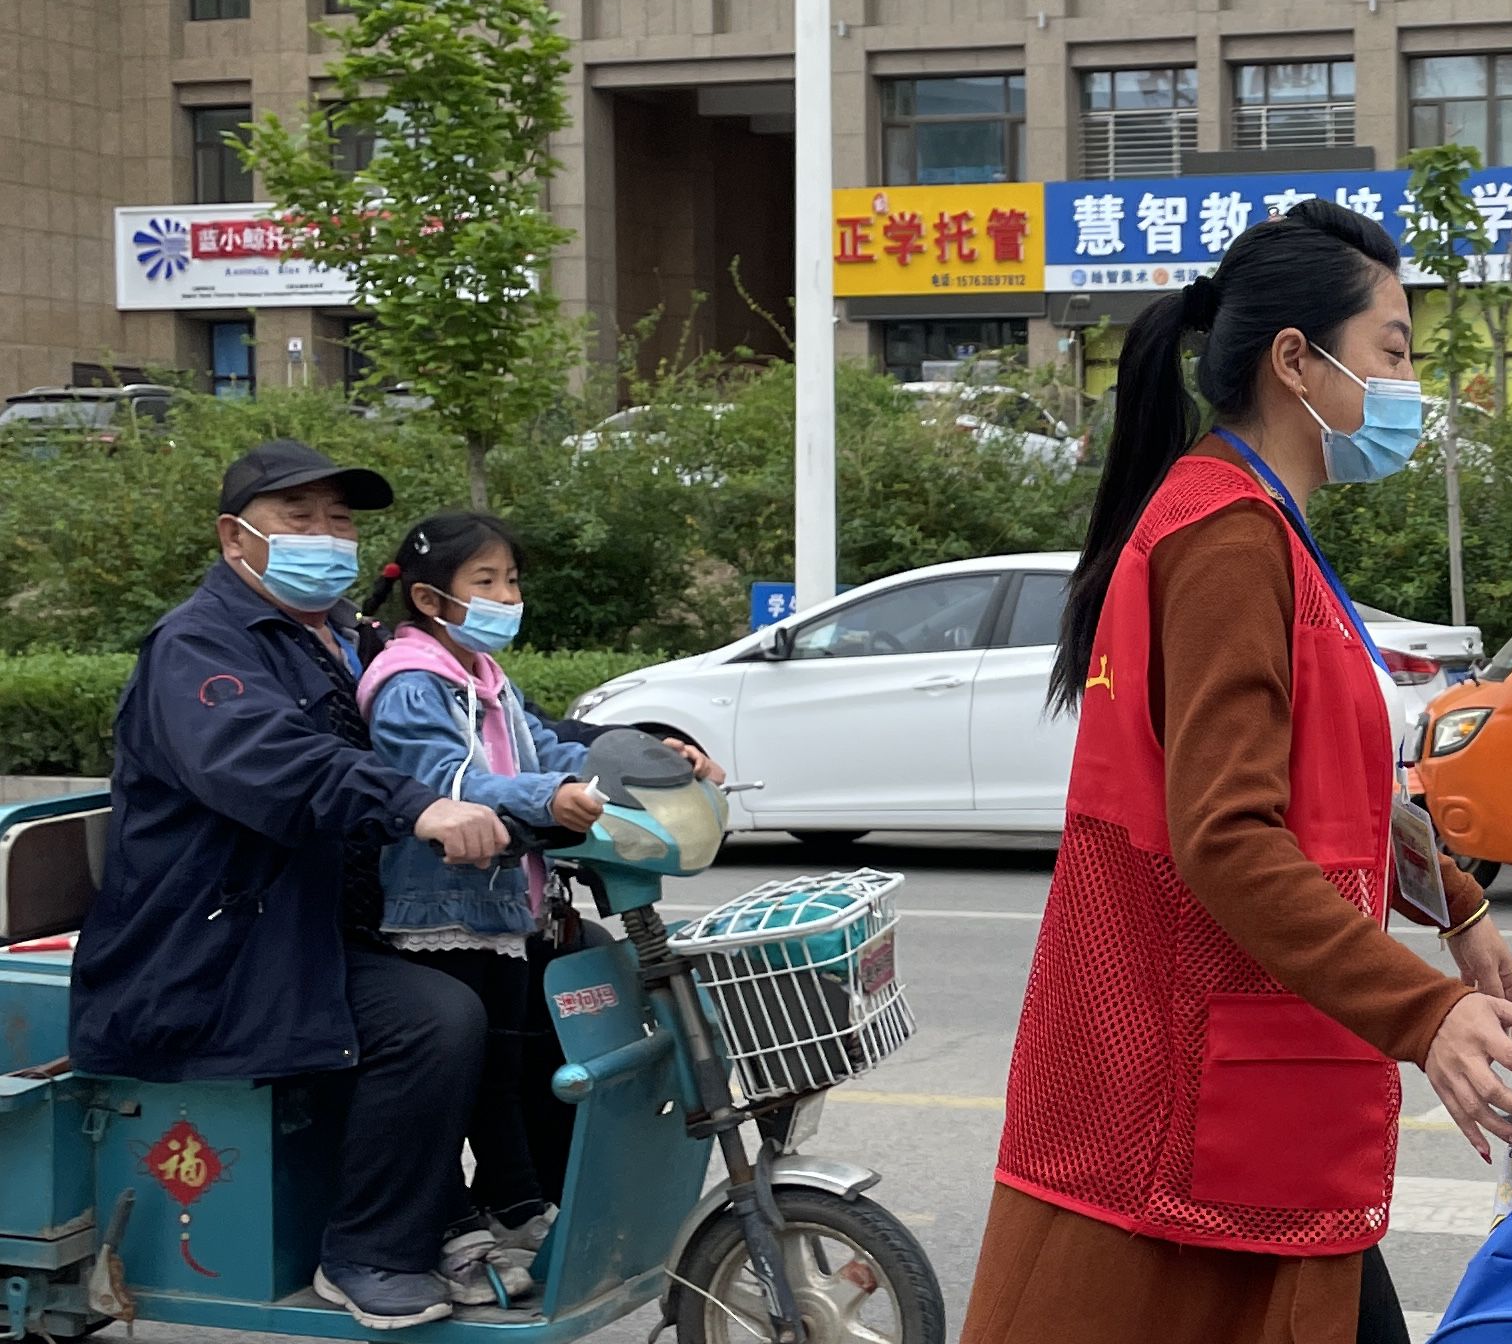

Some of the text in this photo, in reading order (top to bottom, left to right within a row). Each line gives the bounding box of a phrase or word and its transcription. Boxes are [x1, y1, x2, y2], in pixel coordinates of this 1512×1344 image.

[834, 208, 1028, 266] 正学托管
[158, 1134, 208, 1188] 福
